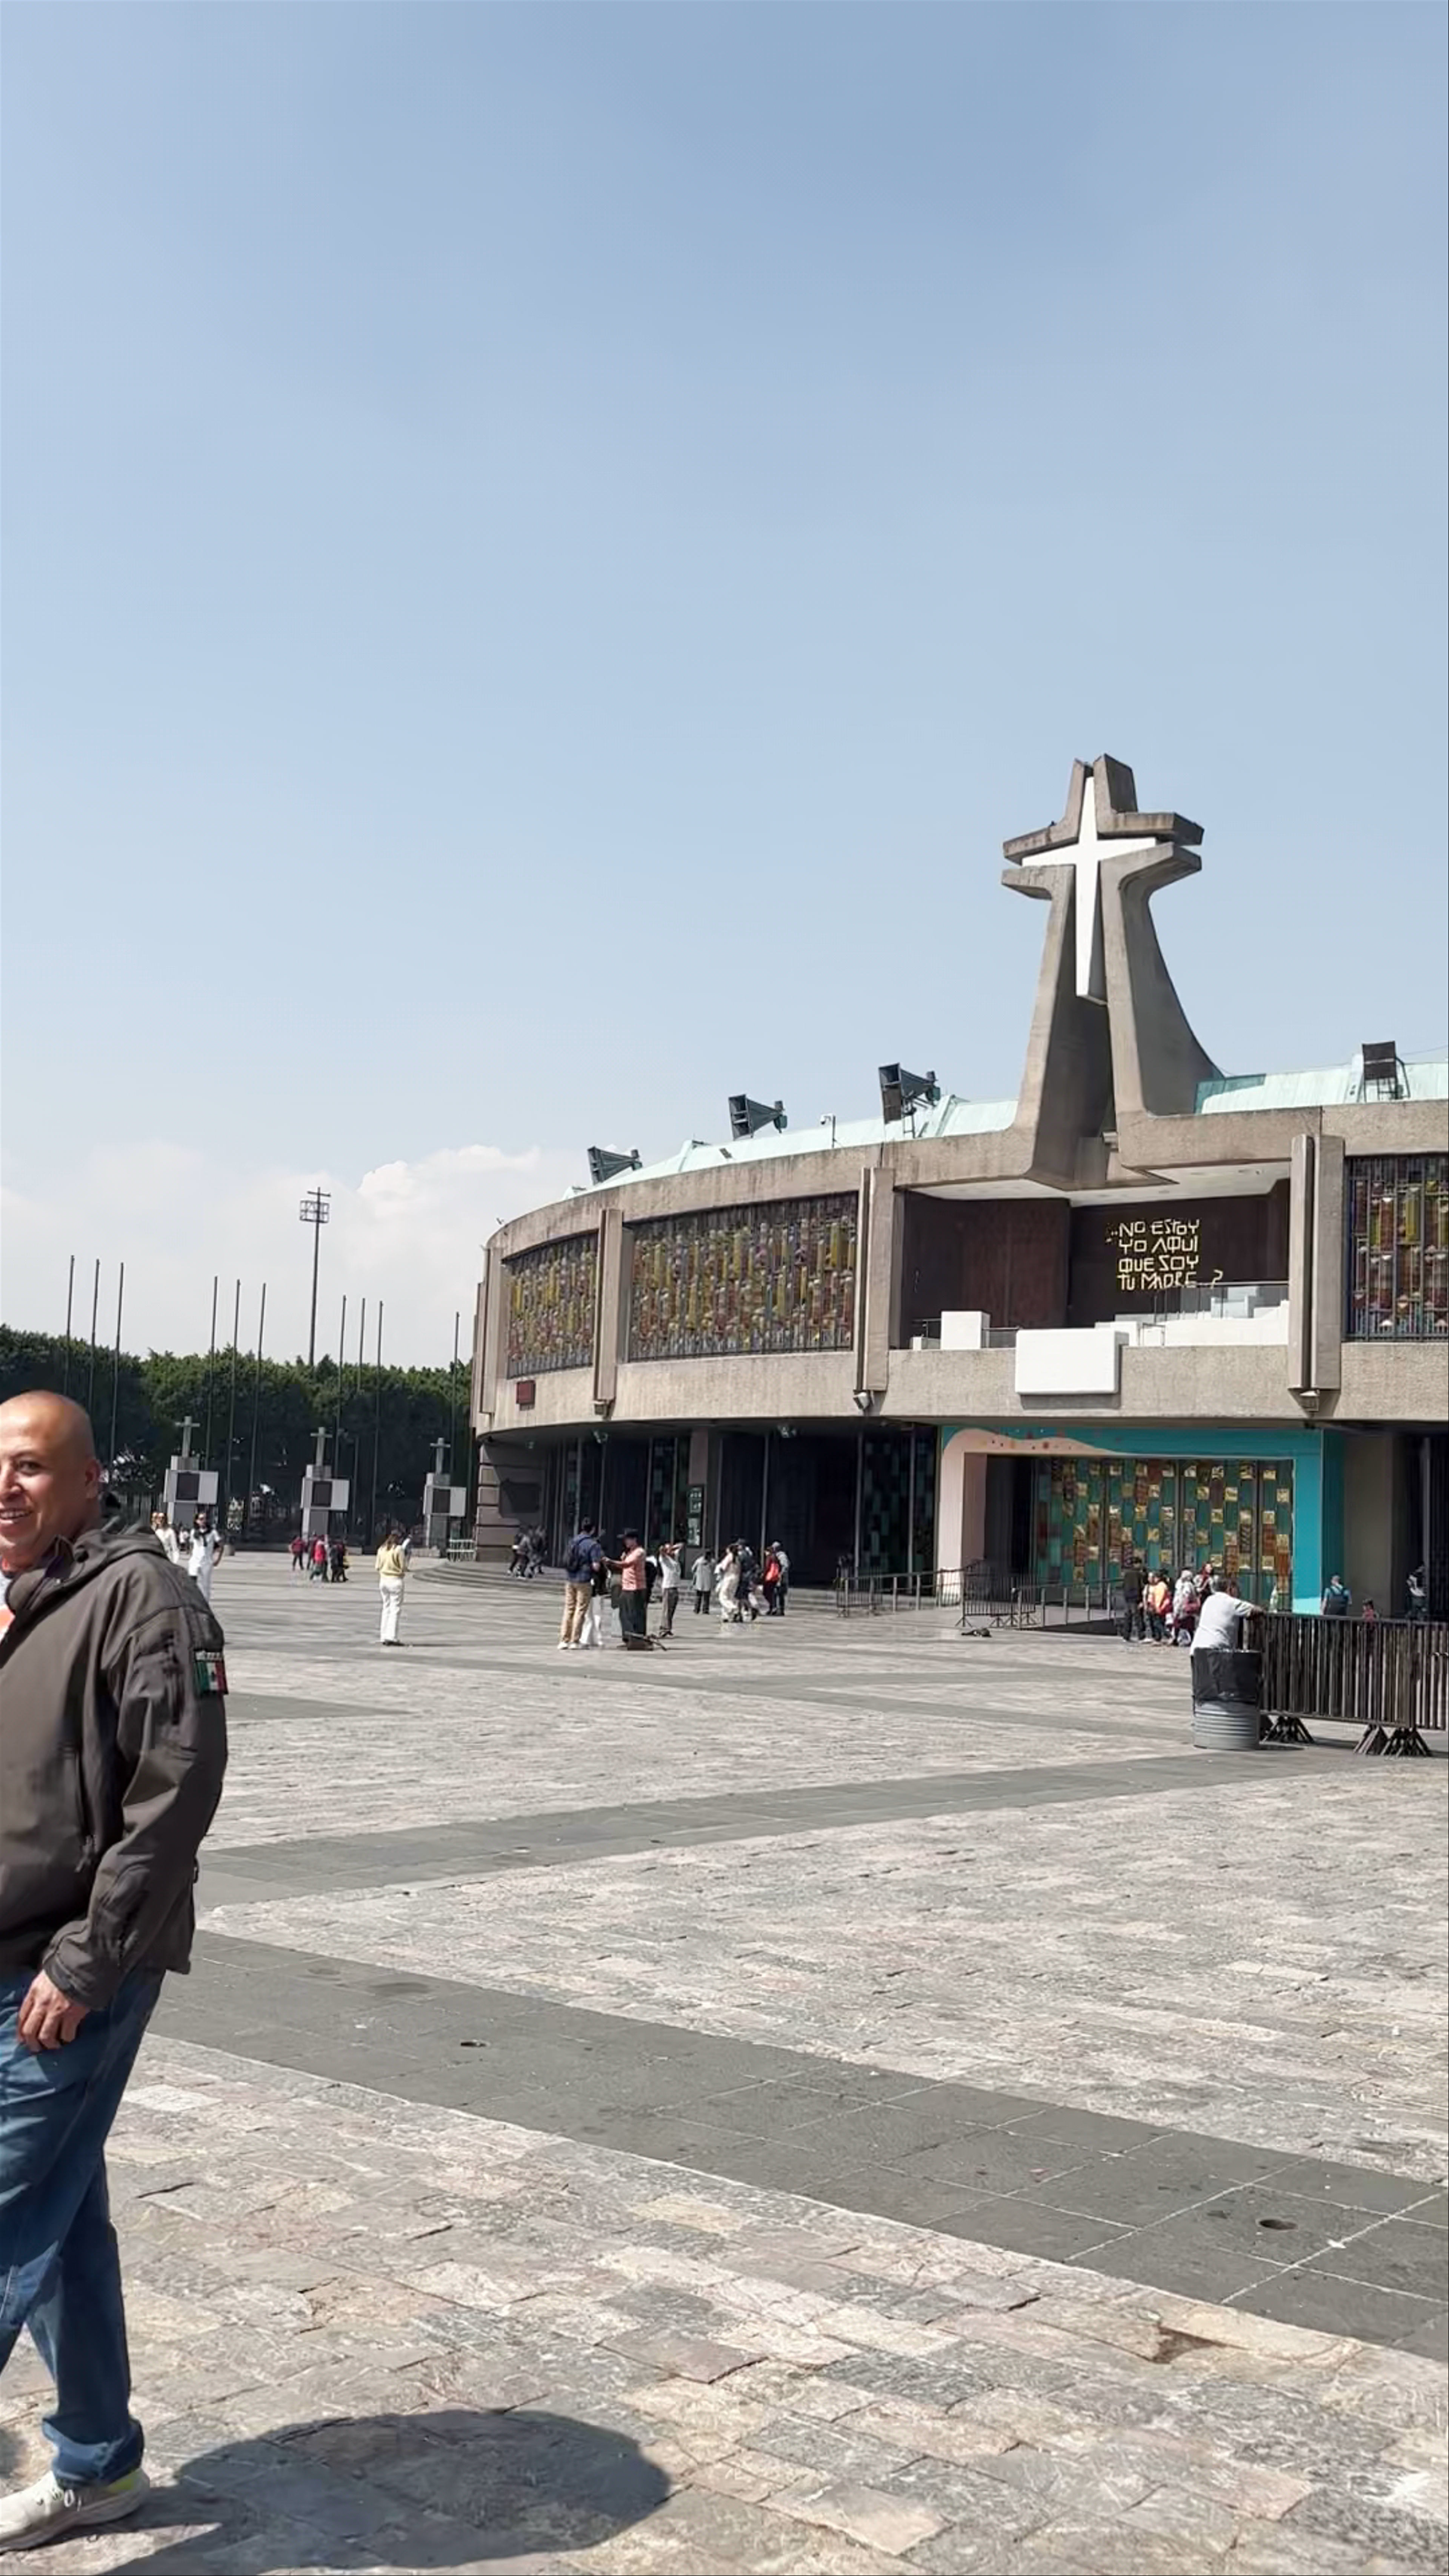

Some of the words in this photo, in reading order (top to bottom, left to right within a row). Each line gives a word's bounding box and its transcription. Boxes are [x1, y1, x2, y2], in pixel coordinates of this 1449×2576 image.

[1119, 1239, 1147, 1255] YO
[1119, 1258, 1155, 1273] QUE
[1158, 1255, 1199, 1271] SOY
[1117, 1273, 1135, 1290] TU
